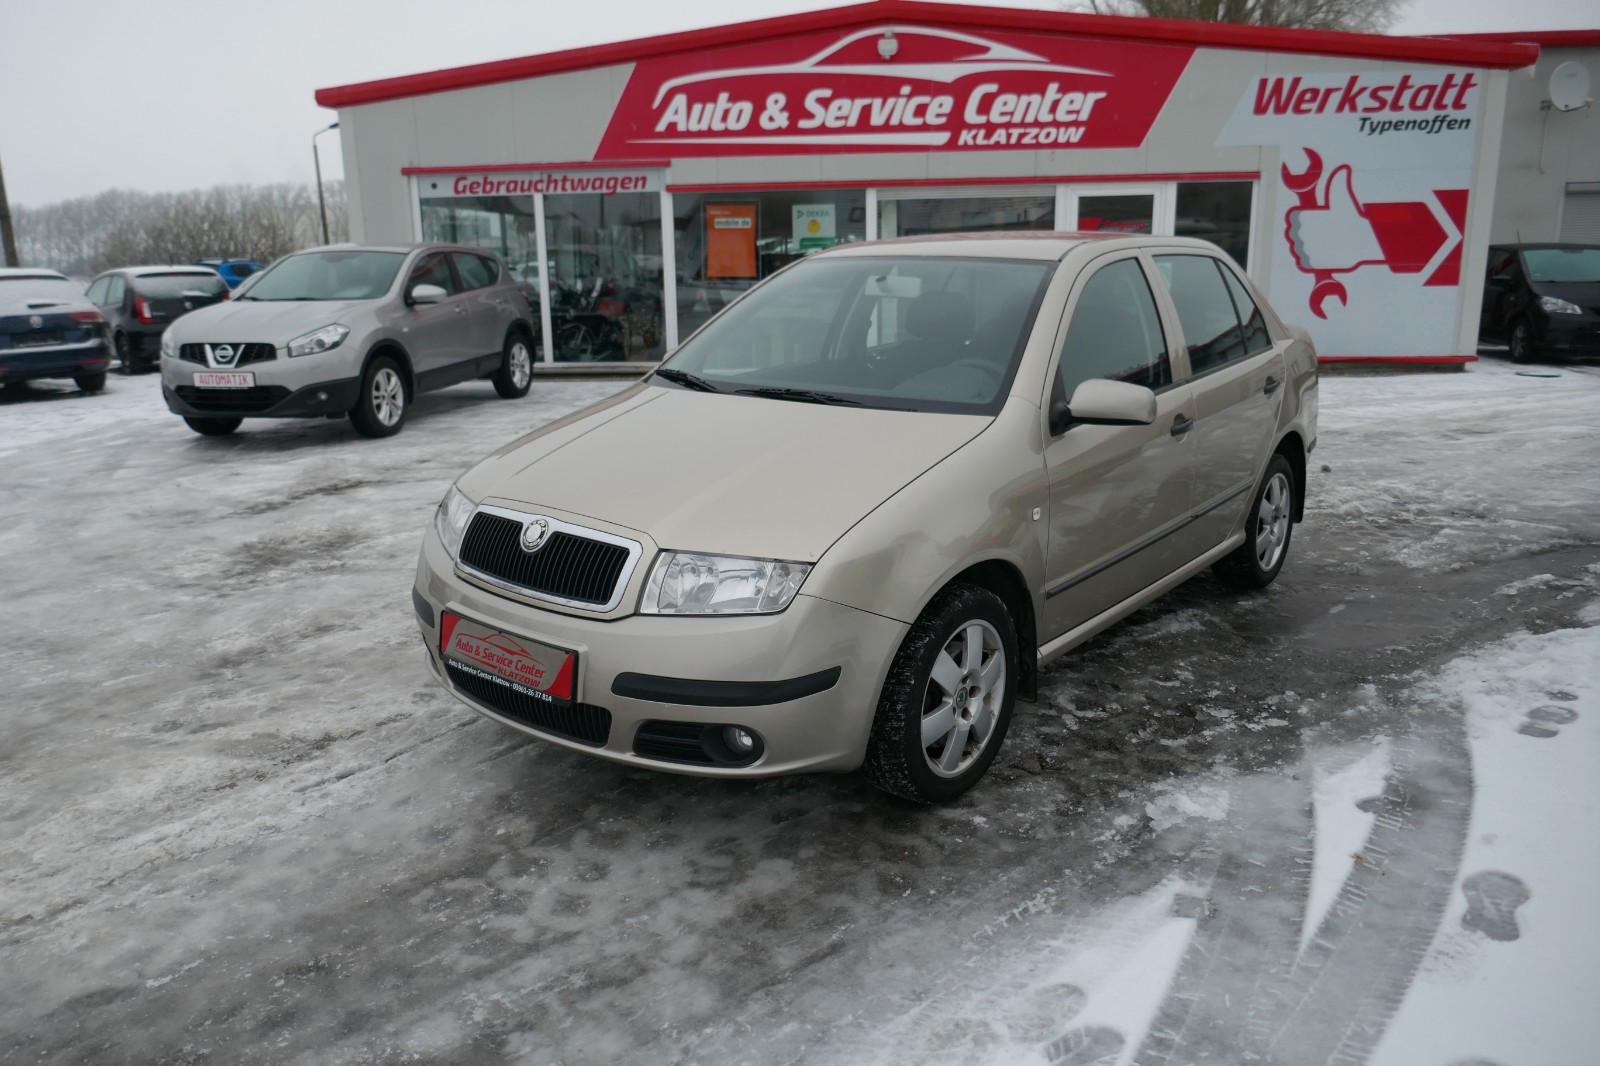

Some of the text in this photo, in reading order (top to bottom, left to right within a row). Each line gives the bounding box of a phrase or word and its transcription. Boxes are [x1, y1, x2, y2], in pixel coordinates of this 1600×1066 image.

[1253, 73, 1478, 117] Werkstatt
[654, 81, 1108, 133] Auto & Service Center
[957, 125, 1087, 147] KLATZOW
[1358, 115, 1471, 137] Typenoffen
[453, 174, 648, 196] Gebrauchtwagen
[199, 373, 249, 386] AUTOMATIK
[455, 638, 545, 679] Auto & Service Center
[448, 658, 458, 668] Auto
[461, 663, 477, 675] Service
[477, 669, 492, 681] Center
[492, 675, 510, 687] Klatzow
[497, 667, 541, 688] KLATZOW
